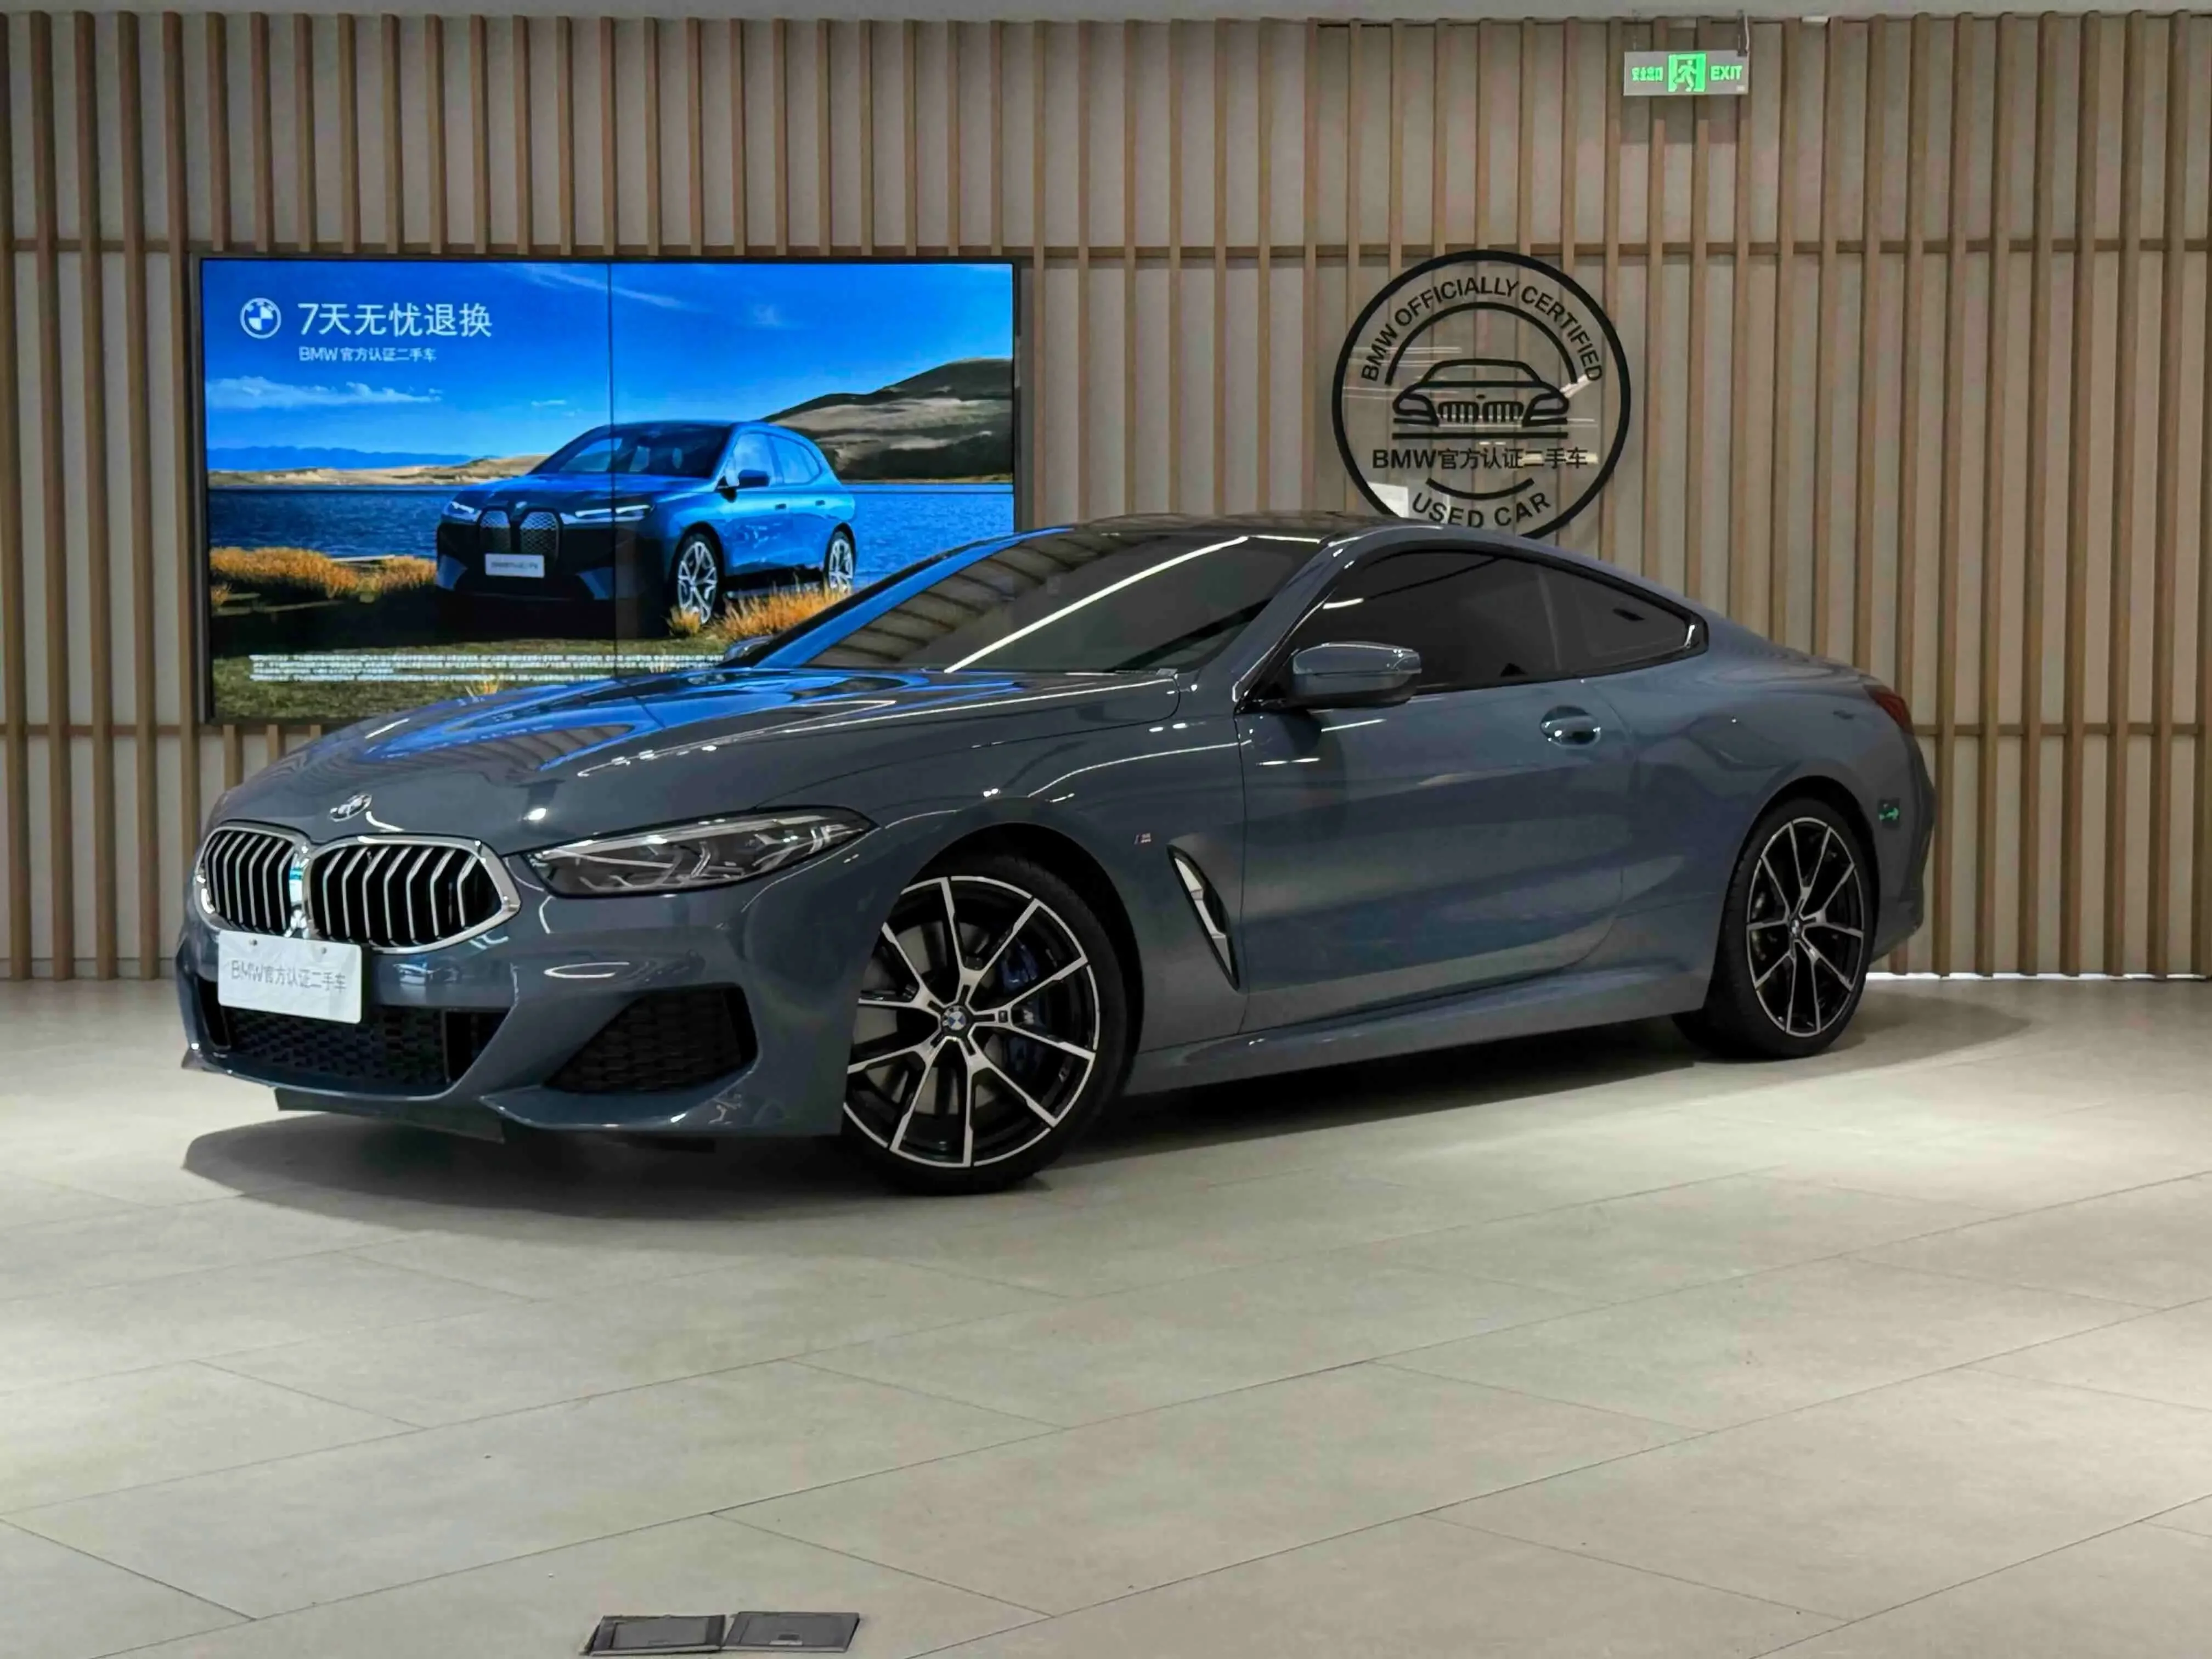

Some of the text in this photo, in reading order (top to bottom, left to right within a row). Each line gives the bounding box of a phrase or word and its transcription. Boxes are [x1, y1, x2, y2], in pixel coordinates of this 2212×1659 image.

[1710, 65, 1743, 81] EXIT
[298, 303, 492, 337] 7天无忧退换
[1362, 276, 1603, 382] BMW OFFICIALLY CERTIFIED
[1412, 492, 1551, 528] USED CAR
